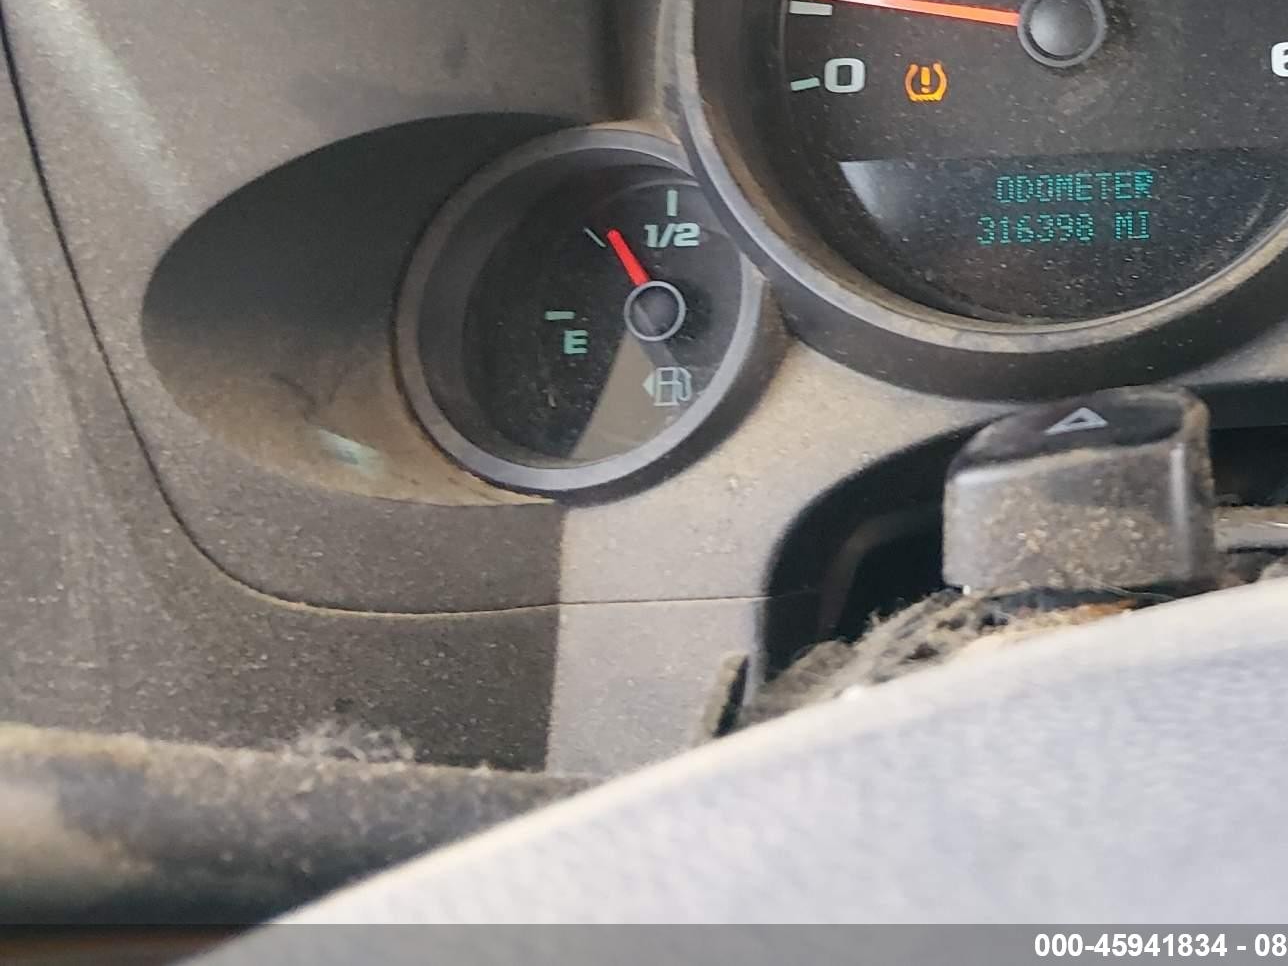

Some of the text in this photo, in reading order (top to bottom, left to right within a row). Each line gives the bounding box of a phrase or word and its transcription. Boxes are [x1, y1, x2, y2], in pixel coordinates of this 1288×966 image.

[823, 58, 866, 94] 0
[996, 170, 1153, 203] ODOMETER
[644, 223, 700, 248] 1/2
[976, 210, 1150, 245] 316398 MI
[563, 329, 589, 355] E
